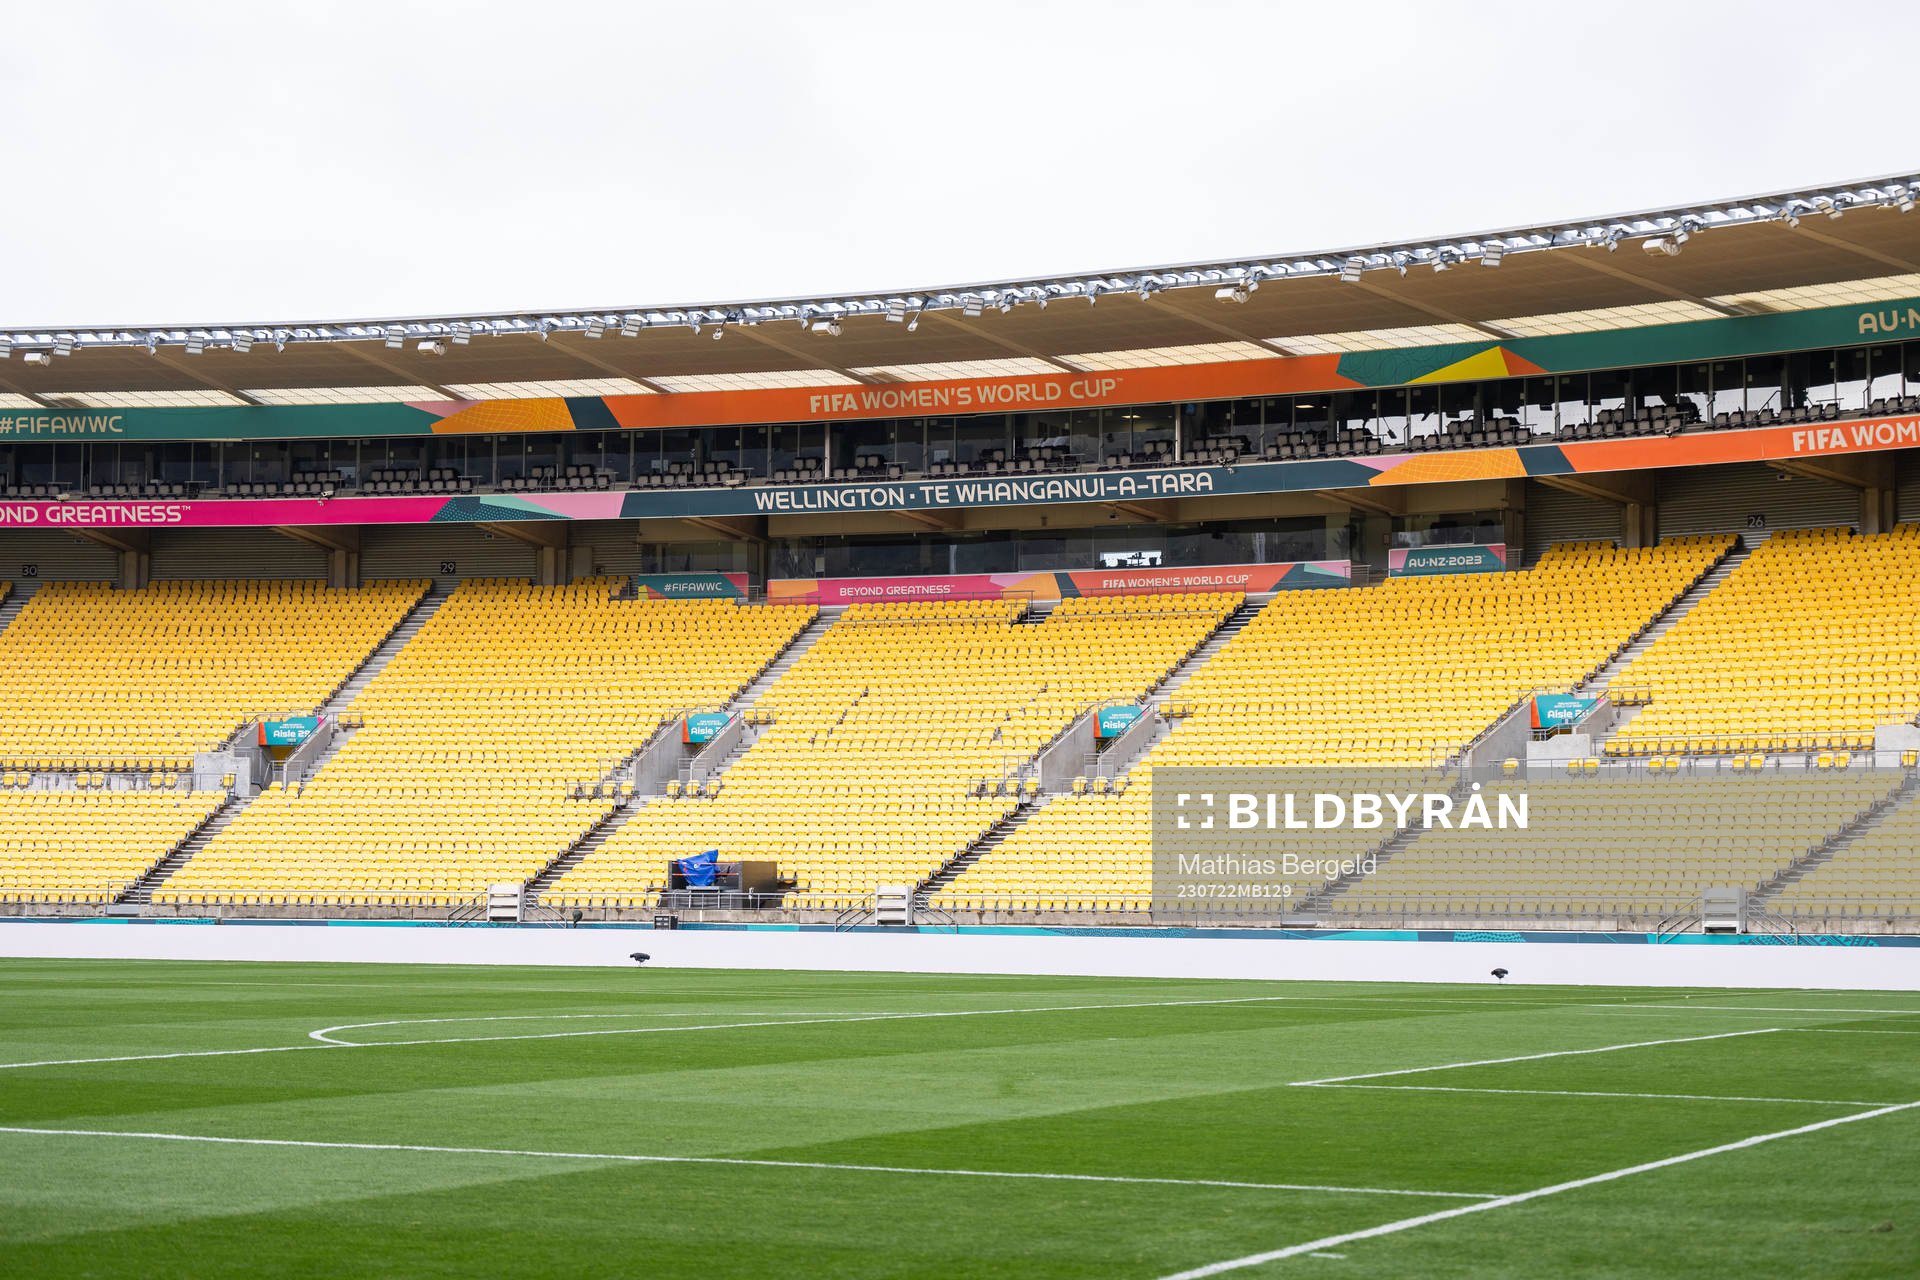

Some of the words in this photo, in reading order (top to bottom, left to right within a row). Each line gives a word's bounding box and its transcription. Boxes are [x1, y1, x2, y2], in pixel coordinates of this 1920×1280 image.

[810, 393, 859, 414] FIFA
[861, 386, 972, 411] WOMEN'S
[976, 382, 1062, 405] WORLD
[0, 415, 123, 434] #FIFAWWC
[1792, 427, 1848, 452] FIFA
[1850, 421, 1920, 447] WOM
[754, 487, 905, 510] WELLINGTON
[919, 485, 950, 504] TE
[955, 472, 1214, 503] WHANGANUI-A-TARA
[1749, 516, 1764, 528] 26
[23, 565, 37, 576] 30
[441, 562, 455, 573] 29
[664, 582, 723, 592] #FIFAWWC
[1103, 579, 1126, 588] FIFA
[1127, 577, 1181, 588] WOMEN'S
[1183, 575, 1223, 586] WORLD
[839, 587, 884, 597] BEYOND
